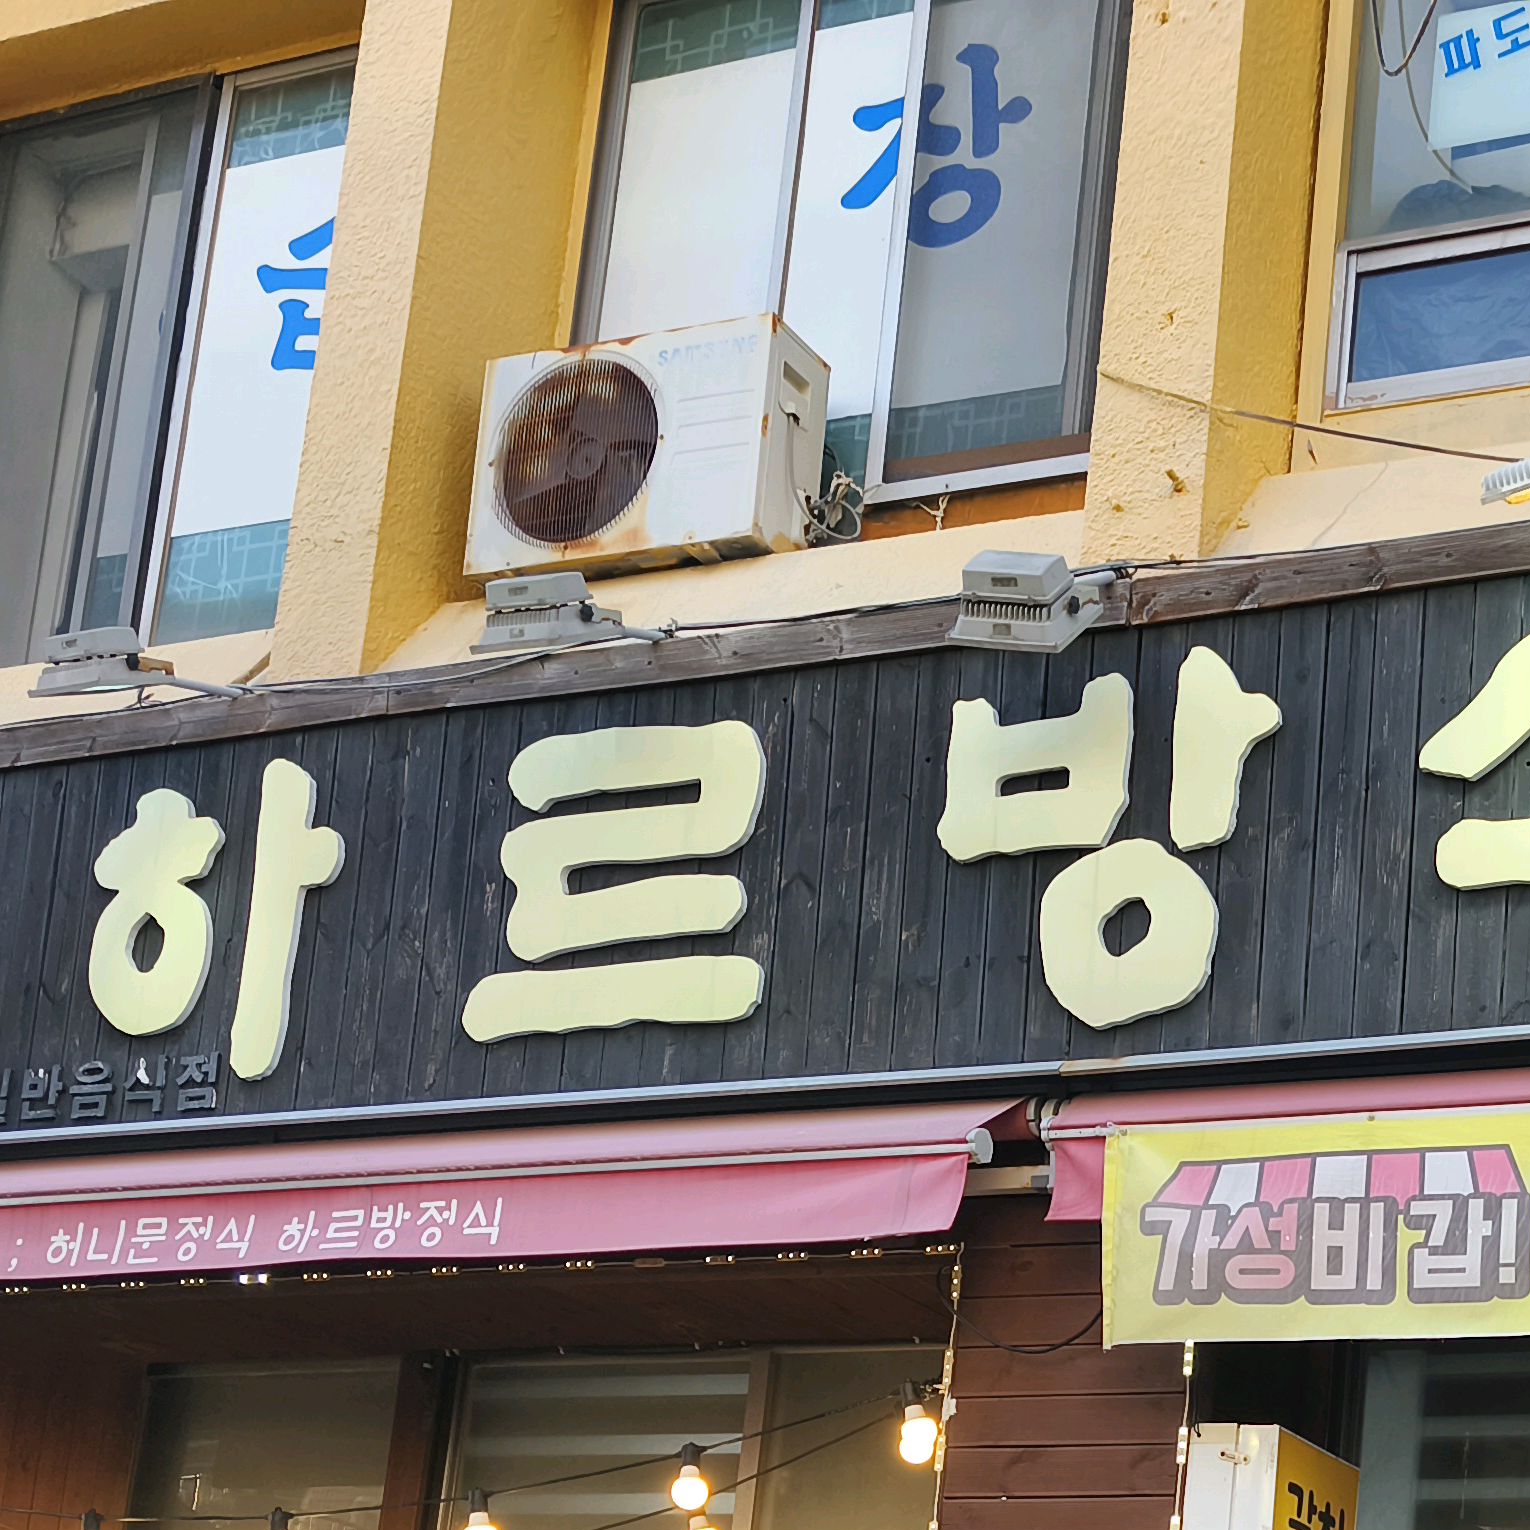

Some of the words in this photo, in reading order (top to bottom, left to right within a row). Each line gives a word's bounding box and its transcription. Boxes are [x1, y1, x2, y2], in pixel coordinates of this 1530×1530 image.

[840, 43, 1033, 249] 장
[46, 1213, 257, 1267] 허니문정식
[277, 1197, 505, 1252] 하르방정식
